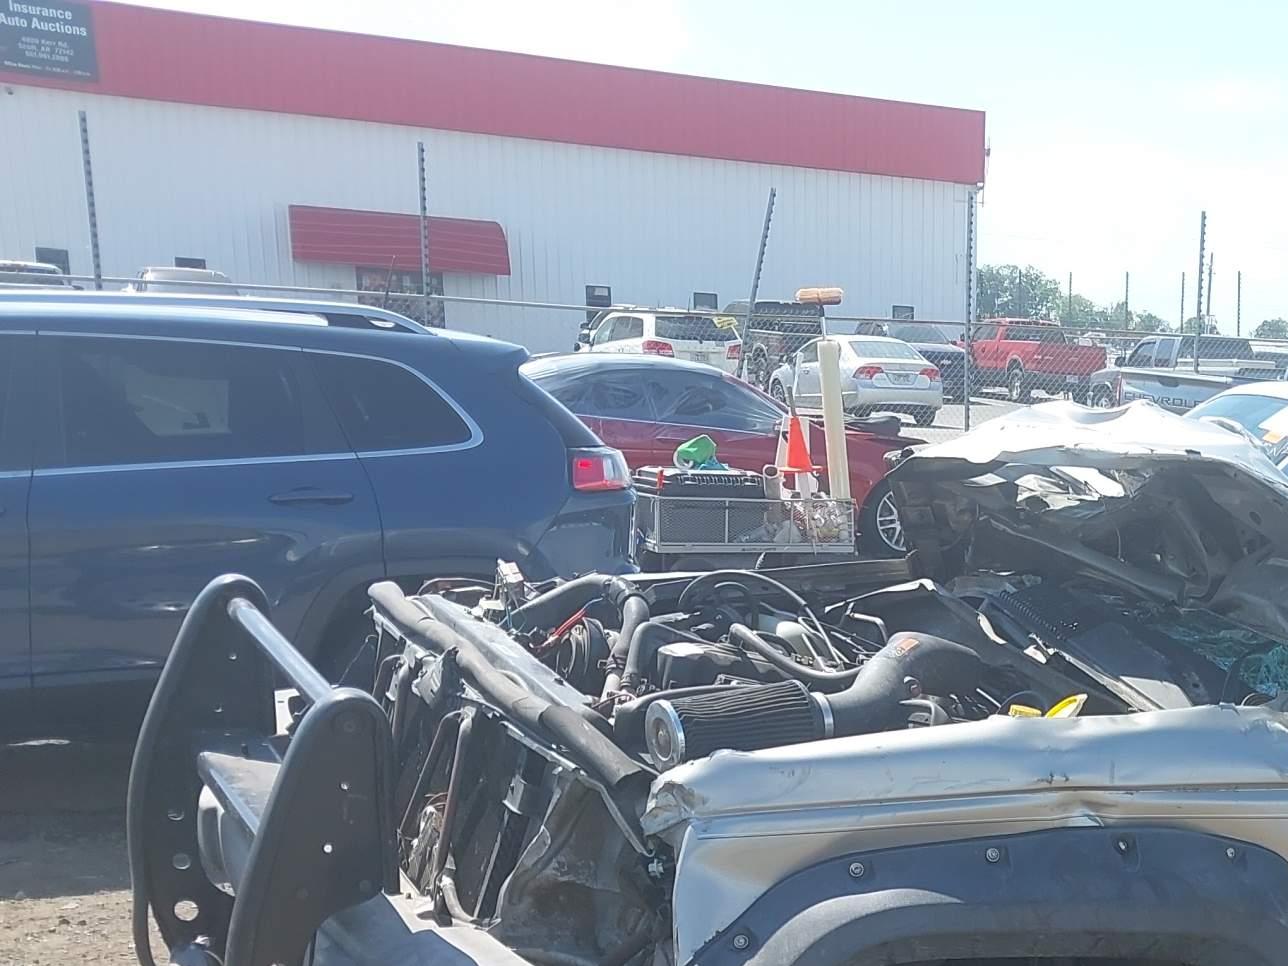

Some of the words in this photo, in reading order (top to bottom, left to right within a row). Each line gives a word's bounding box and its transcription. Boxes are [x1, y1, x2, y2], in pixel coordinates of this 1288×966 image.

[9, 0, 73, 20] Insurance
[0, 13, 28, 28] Auto
[31, 17, 87, 36] Auctions
[1125, 391, 1201, 409] CHEVROLE
